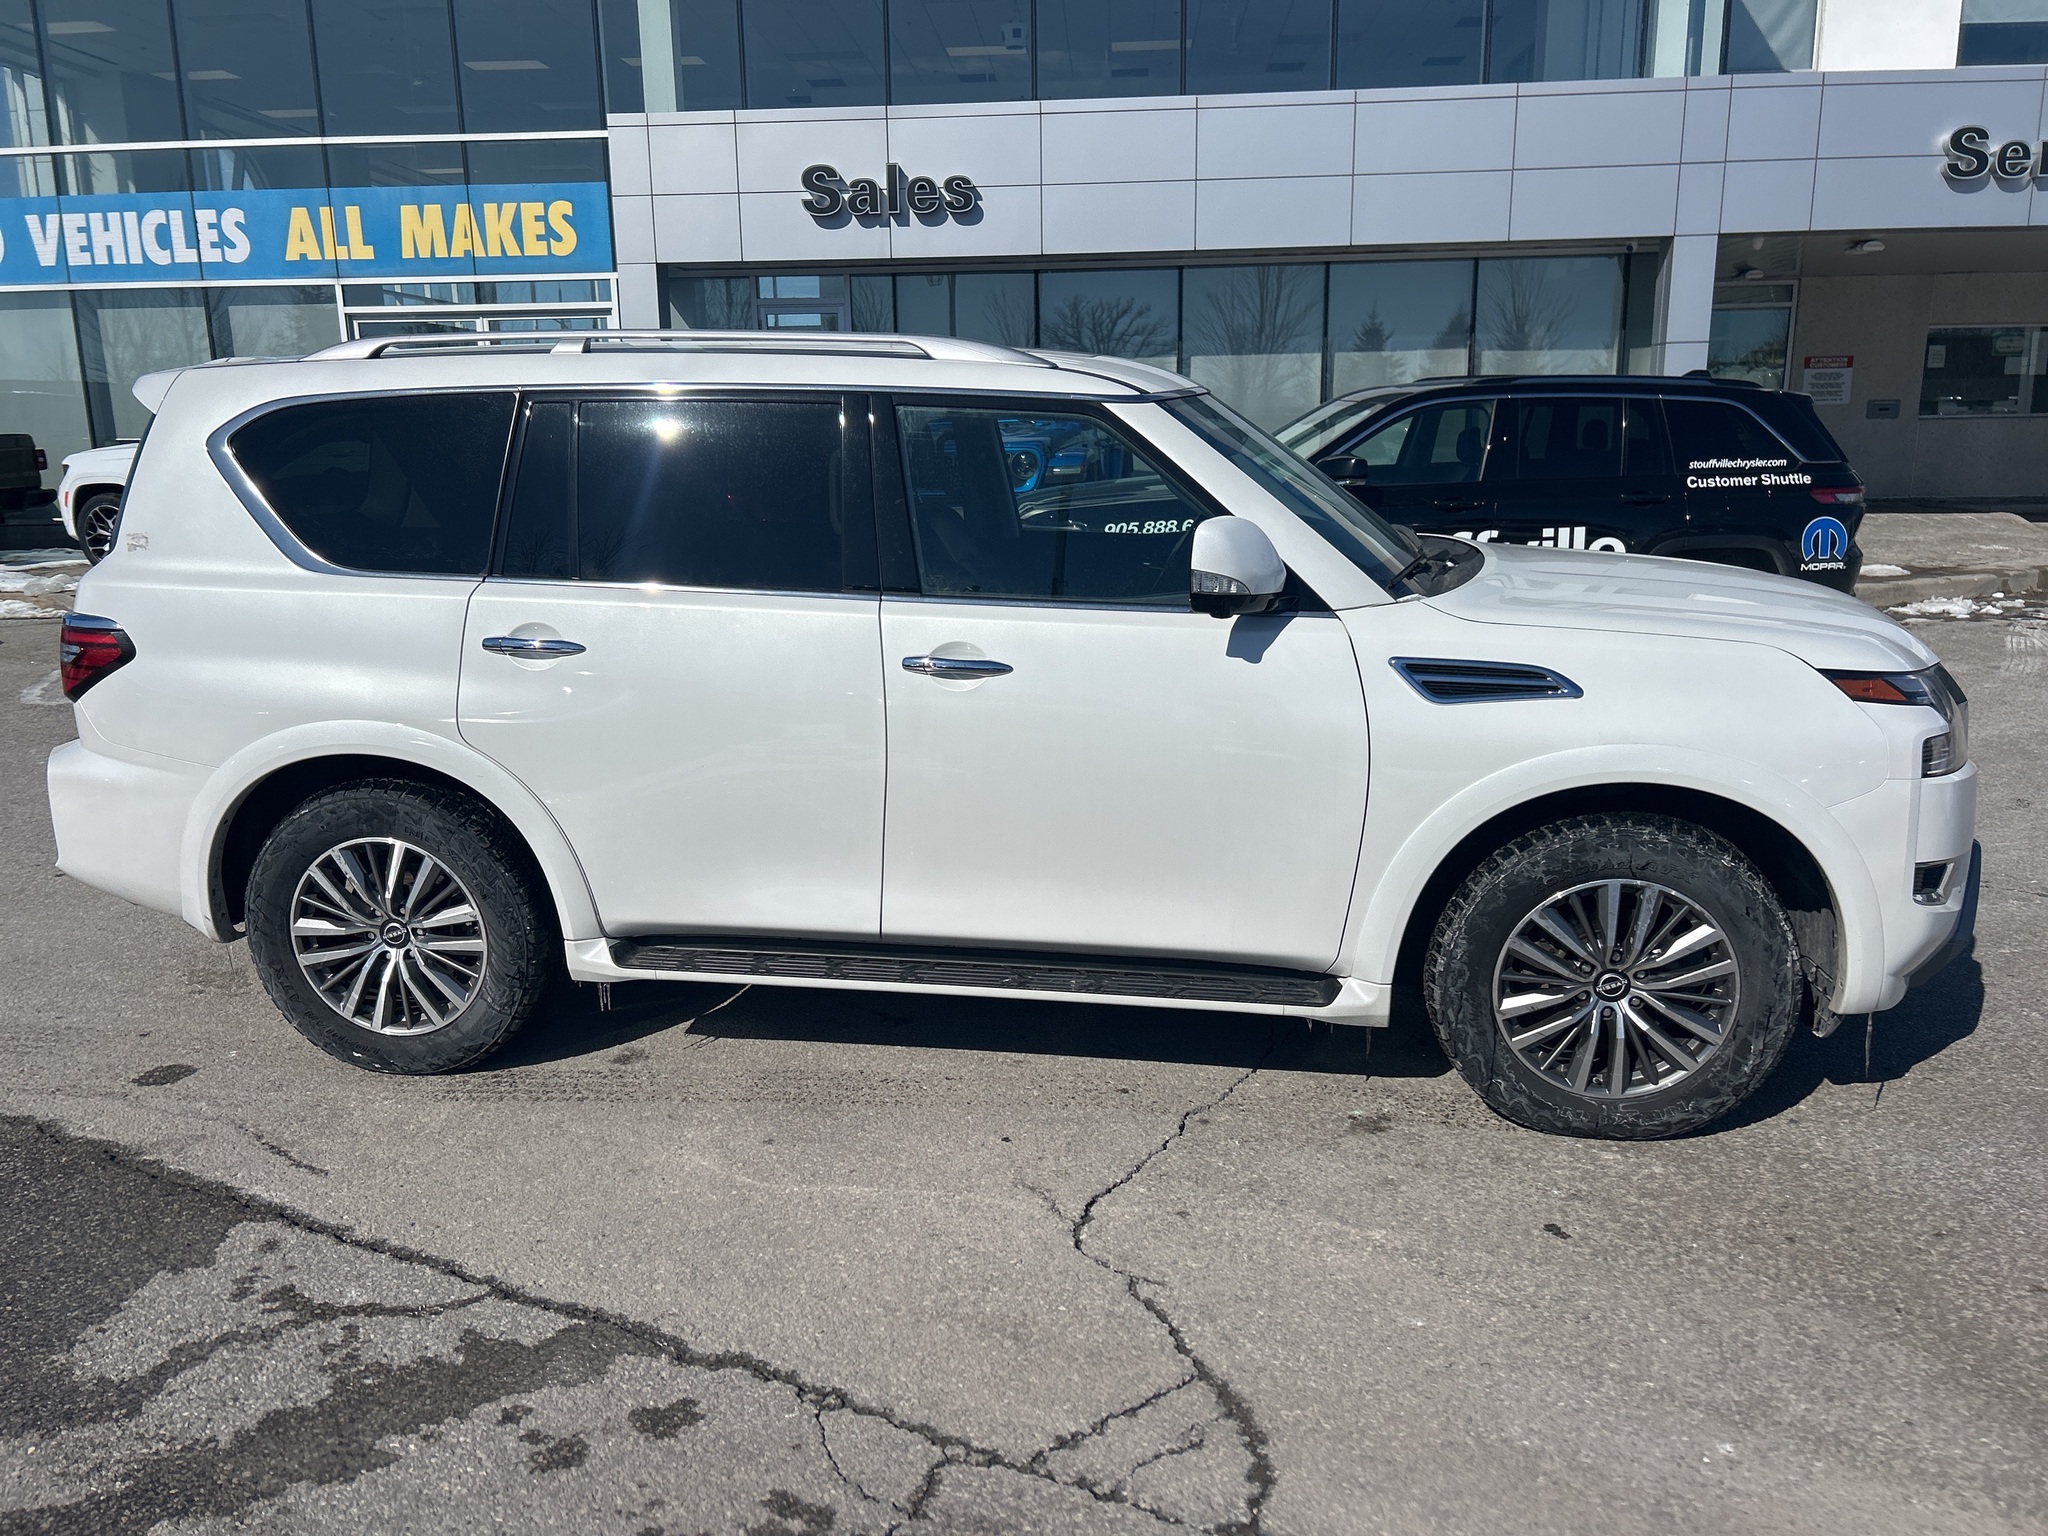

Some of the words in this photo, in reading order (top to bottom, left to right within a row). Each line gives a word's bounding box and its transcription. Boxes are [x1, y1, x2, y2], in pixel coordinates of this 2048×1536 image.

[801, 162, 976, 216] Sales
[24, 207, 250, 267] VEHICLES
[285, 205, 375, 261] ALL
[400, 200, 577, 259] MAKES
[1689, 457, 1788, 470] stouffvillechrysler.com
[1687, 475, 1758, 488] Customer
[1761, 473, 1812, 485] Shuttle
[1596, 978, 1628, 992] NISSAN
